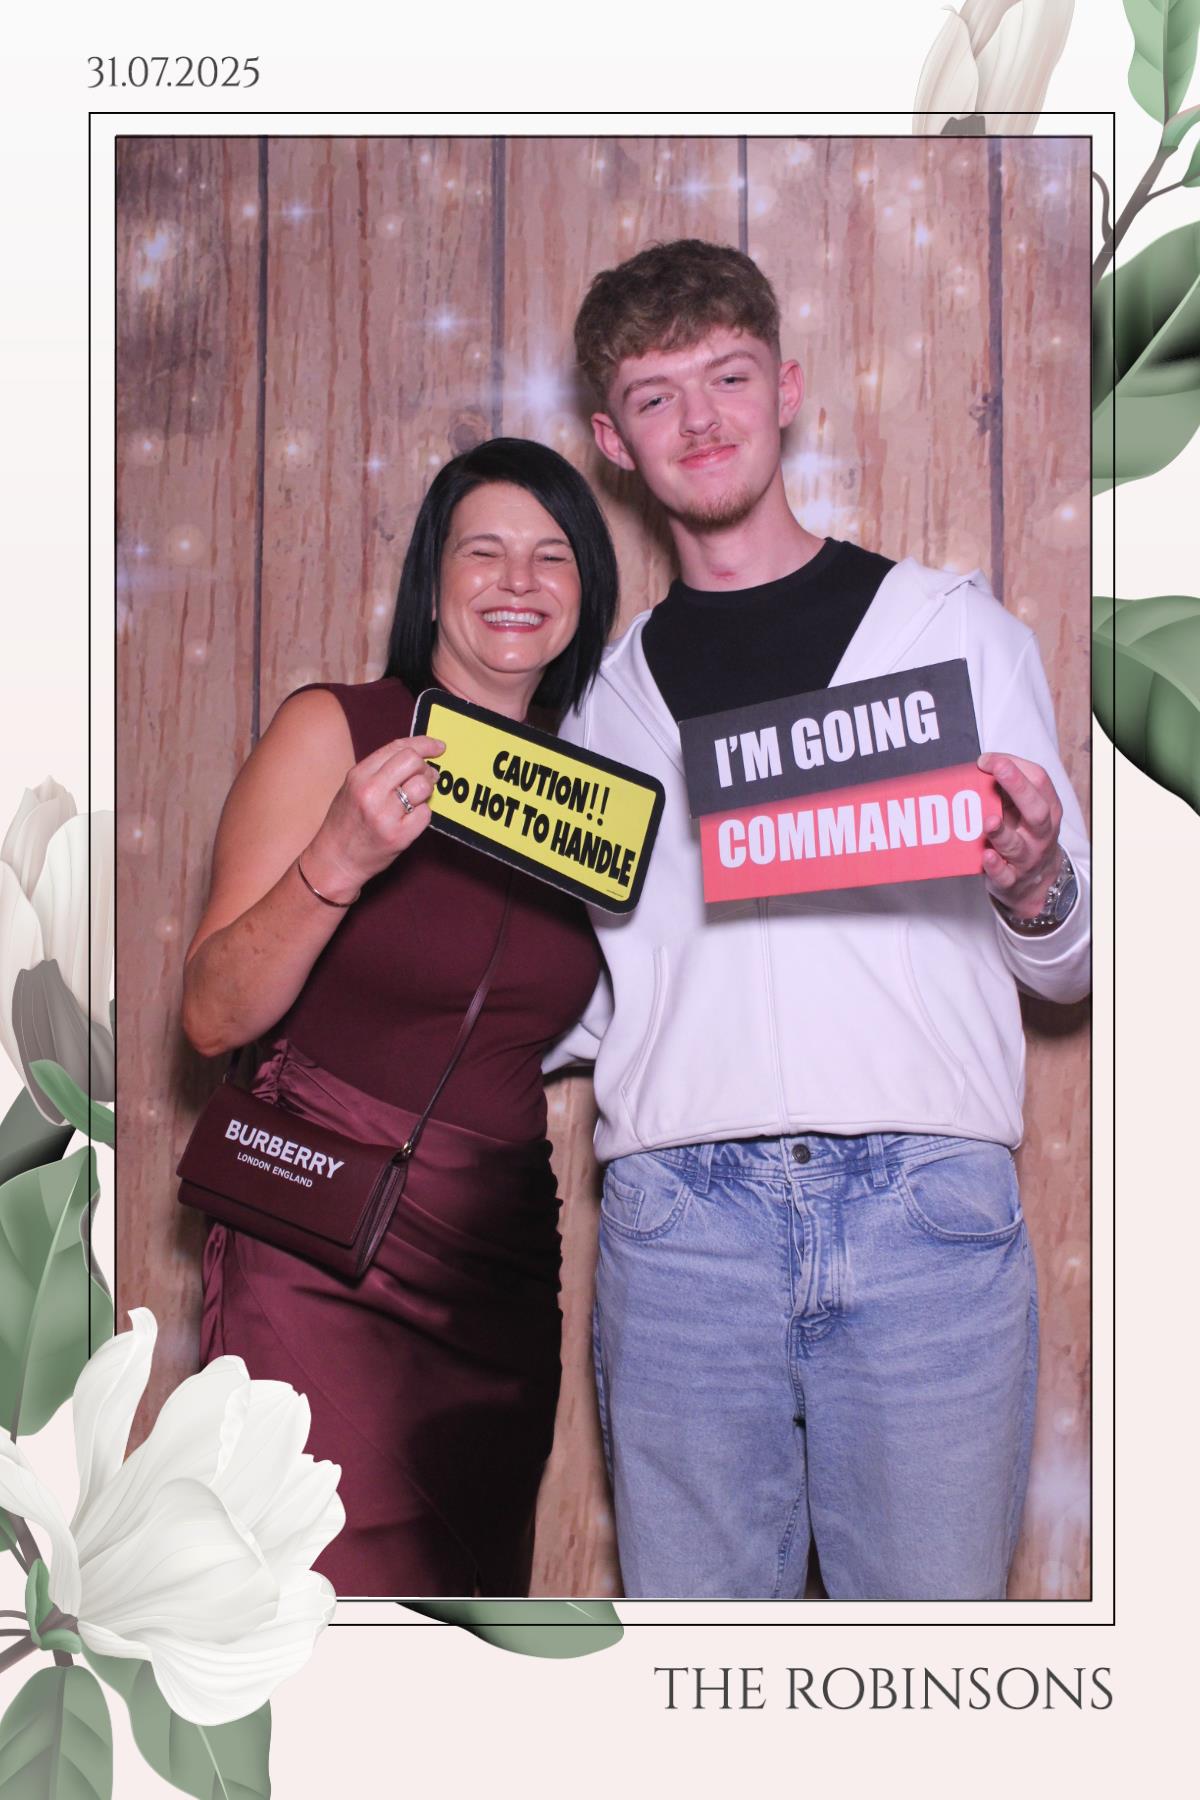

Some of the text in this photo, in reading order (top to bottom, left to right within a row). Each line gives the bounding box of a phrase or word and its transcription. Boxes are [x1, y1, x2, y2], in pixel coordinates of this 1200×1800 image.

[714, 690, 940, 788] I'M GOING
[493, 750, 610, 826] CAUTION!!
[470, 783, 520, 828] HOT
[521, 805, 550, 844] TO
[550, 819, 636, 887] HANDLE
[718, 790, 983, 868] COMMANDO
[224, 1119, 345, 1179] BURBERRY
[237, 1151, 313, 1188] LONDON ENGLAND
